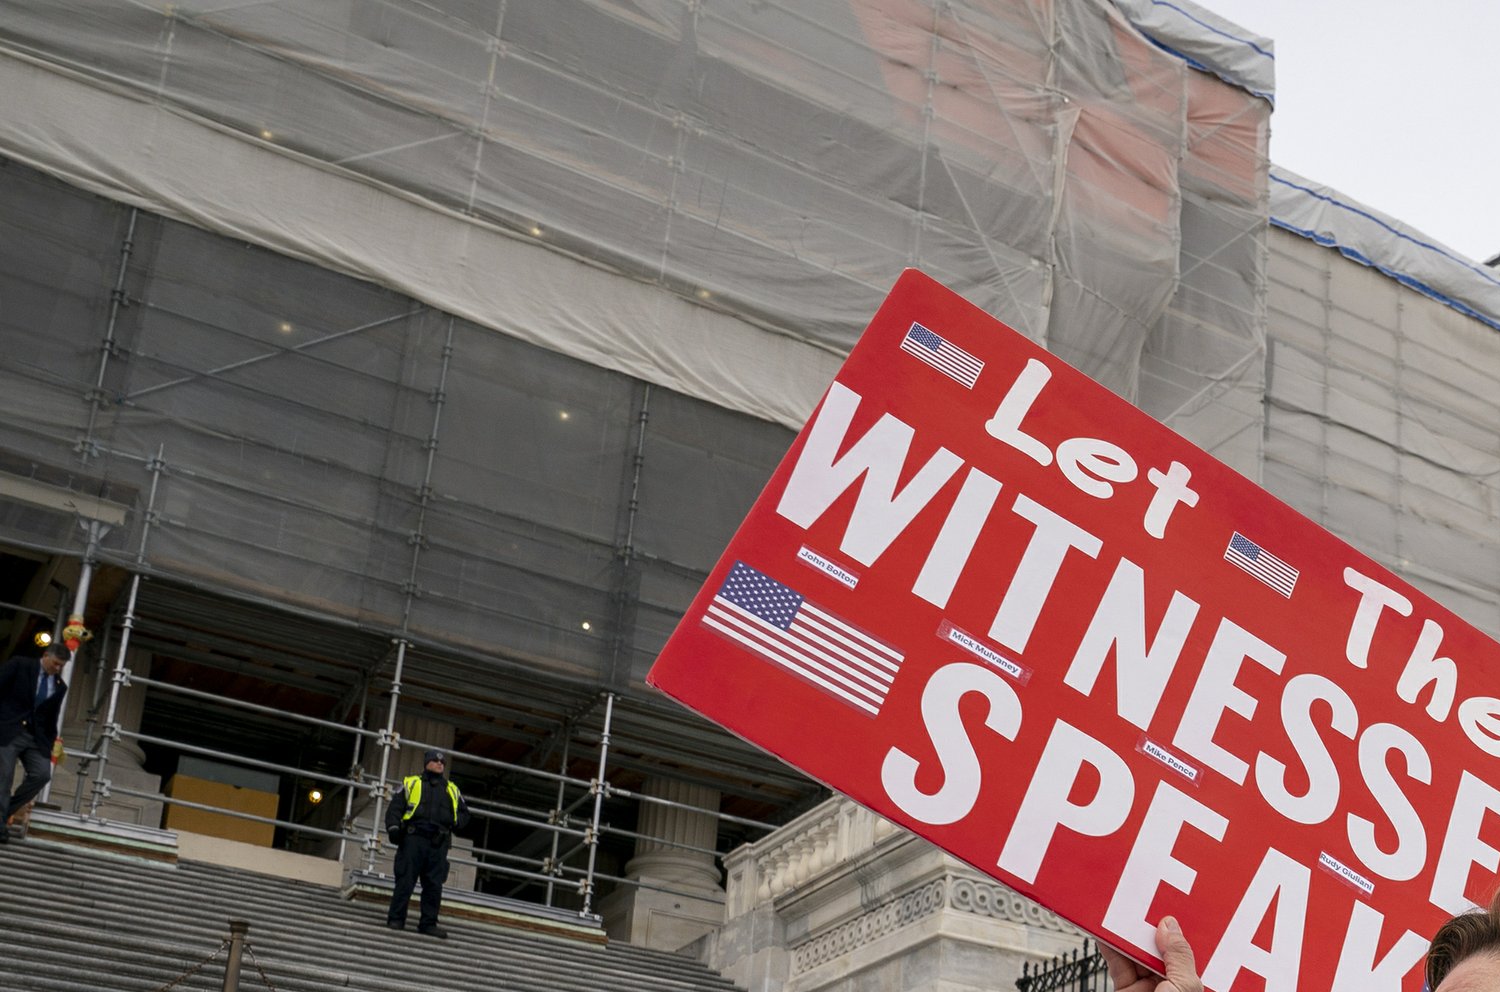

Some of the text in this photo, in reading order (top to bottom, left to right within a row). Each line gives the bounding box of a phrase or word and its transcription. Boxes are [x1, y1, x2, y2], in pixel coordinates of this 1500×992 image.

[985, 358, 1200, 539] Let
[801, 551, 857, 586] John Bolton
[952, 631, 1019, 673] Mick Mulvaney
[1146, 744, 1194, 777] Mike Pence
[1320, 853, 1373, 891] Rudy Giuliani
